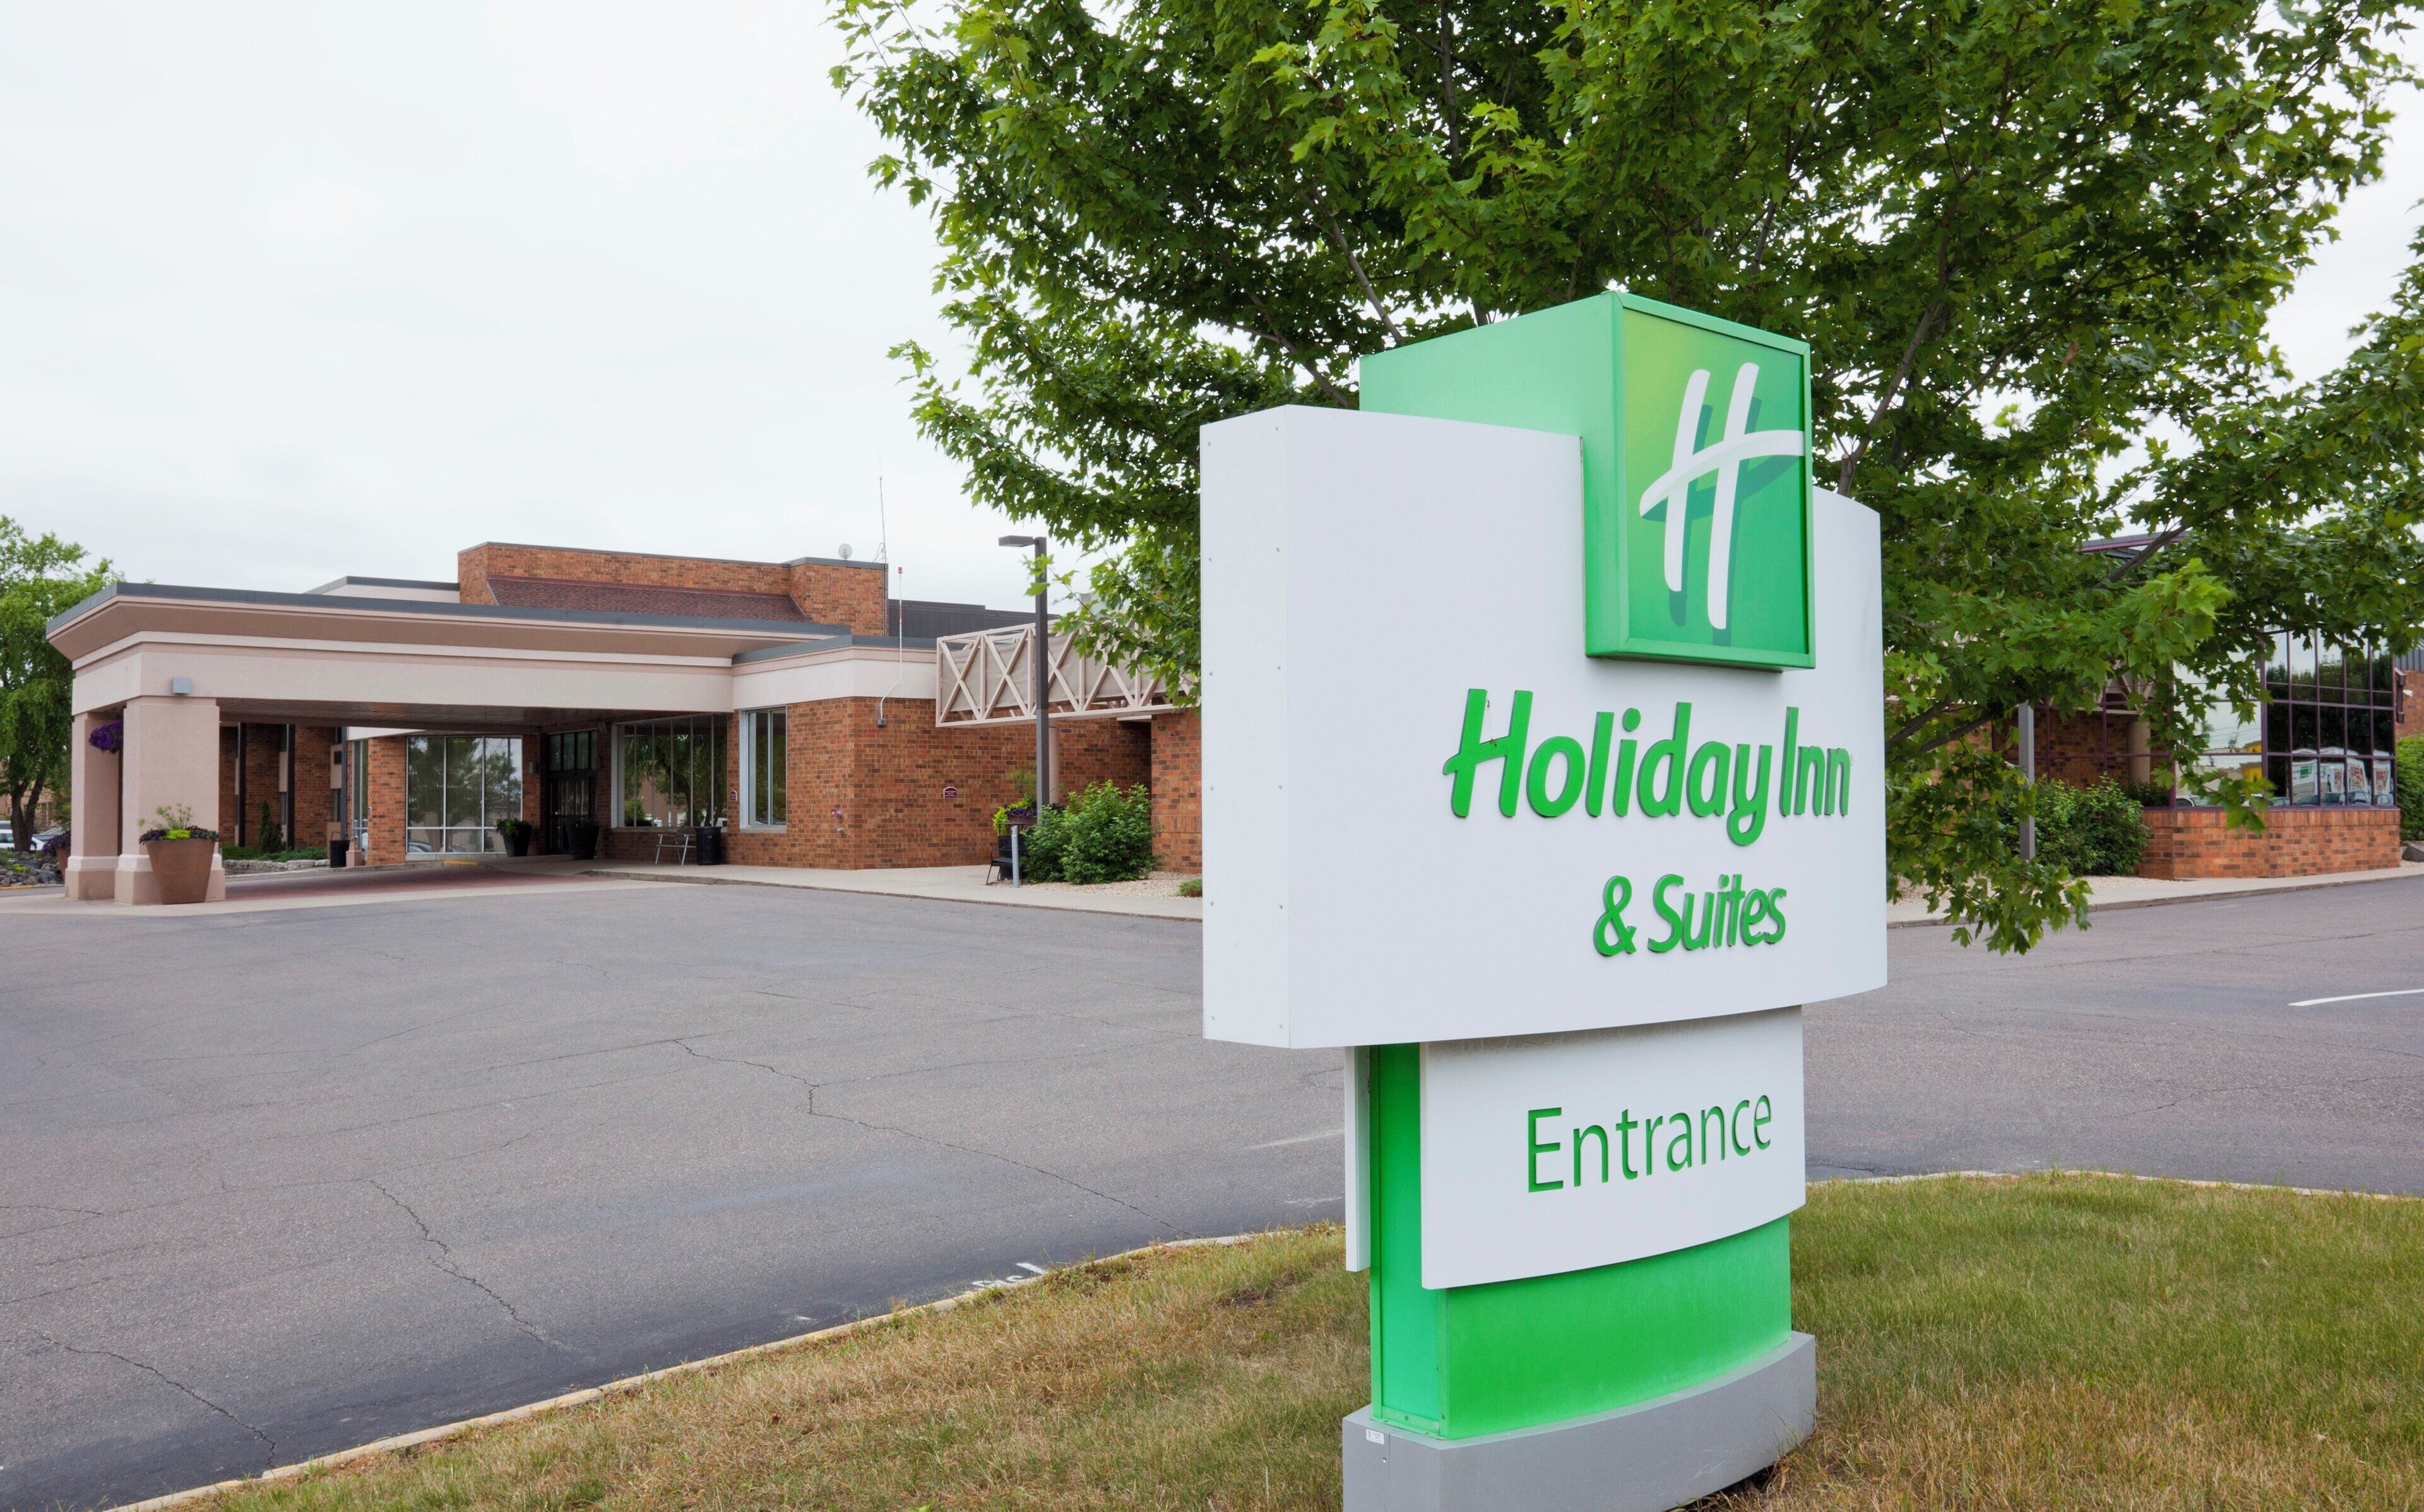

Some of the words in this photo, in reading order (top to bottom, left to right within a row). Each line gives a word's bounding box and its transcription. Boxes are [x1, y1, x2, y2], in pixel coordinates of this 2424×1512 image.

[1443, 688, 1773, 846] Holiday
[1779, 706, 1851, 817] Inn
[1593, 875, 1637, 957] &
[1647, 873, 1787, 954] Suites
[1527, 1094, 1772, 1194] Entrance
